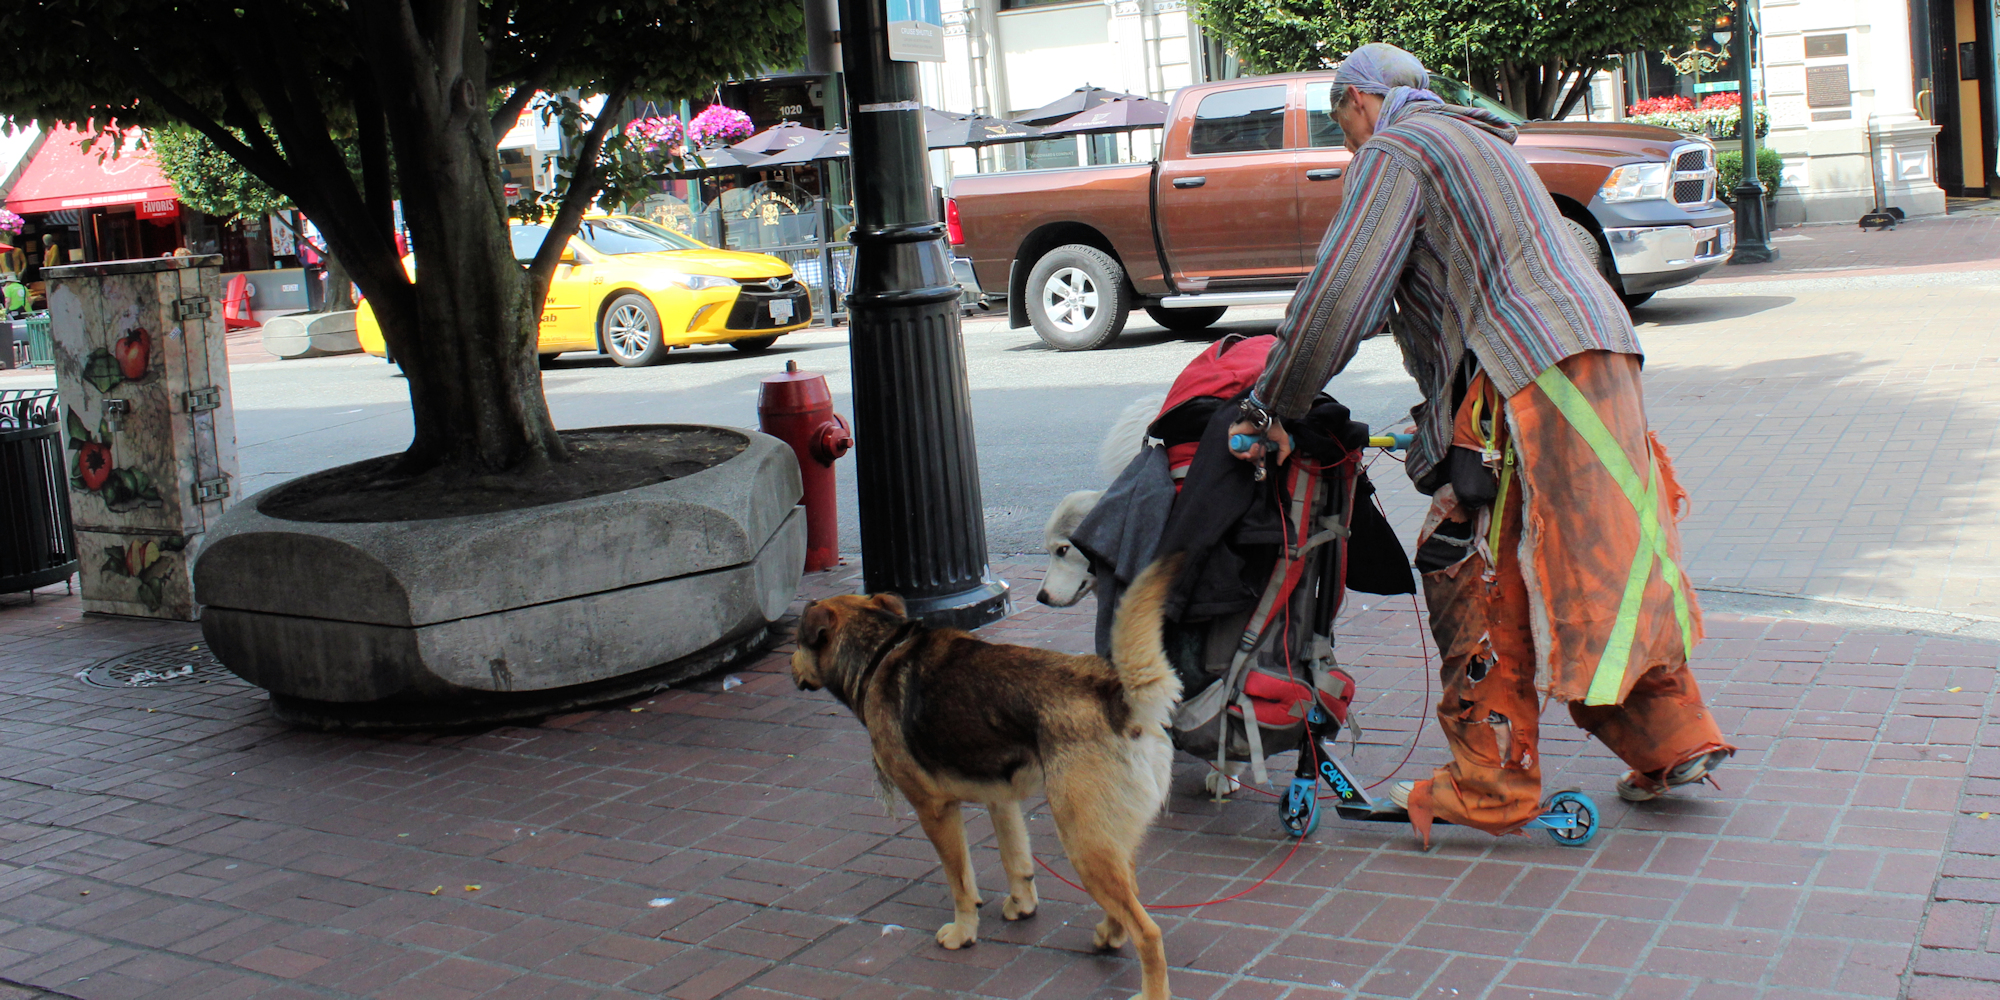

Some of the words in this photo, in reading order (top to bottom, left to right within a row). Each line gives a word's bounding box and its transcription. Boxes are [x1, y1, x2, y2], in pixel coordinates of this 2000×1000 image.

[900, 27, 916, 36] CRUISE
[916, 29, 933, 37] SHUTTLE
[780, 104, 803, 116] 1020
[142, 199, 175, 213] FAVORIS
[742, 198, 761, 219] BARD
[762, 194, 770, 202] &
[770, 191, 800, 215] BANKER
[593, 276, 604, 286] 59
